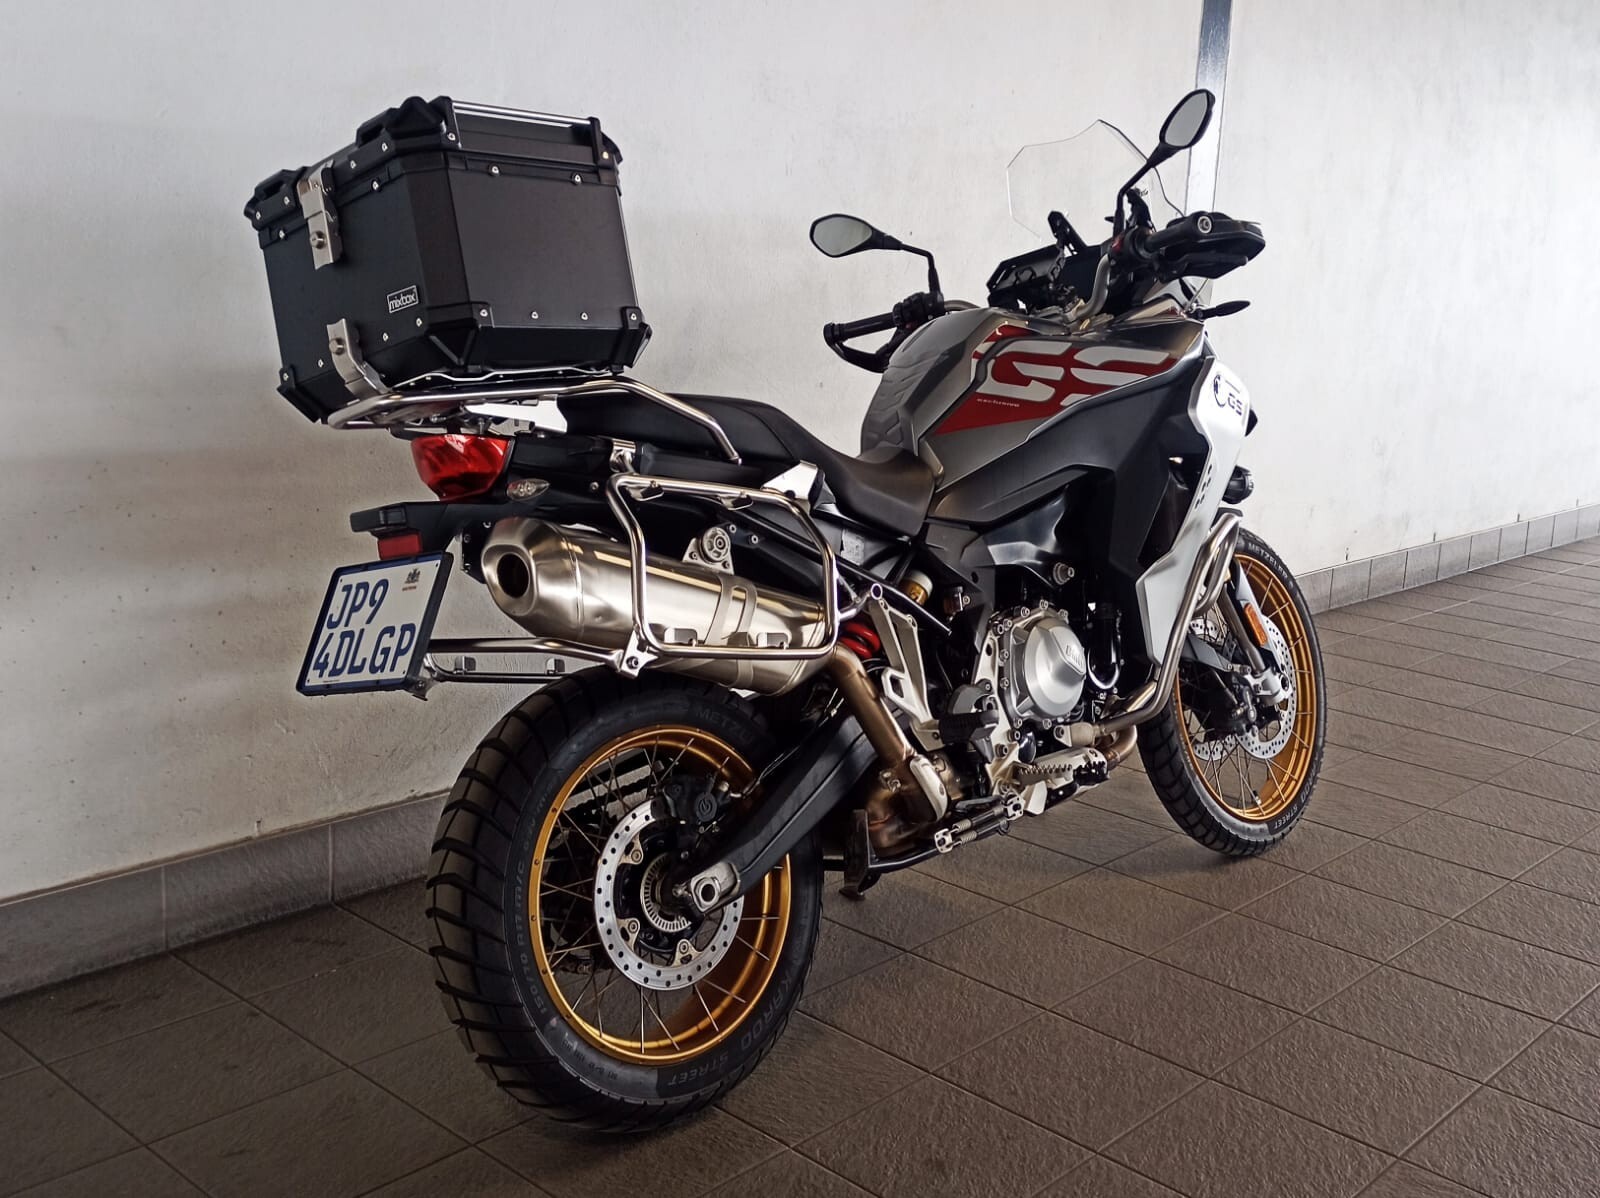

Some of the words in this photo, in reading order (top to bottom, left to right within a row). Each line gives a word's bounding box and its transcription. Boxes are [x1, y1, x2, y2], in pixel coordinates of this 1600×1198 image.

[389, 293, 416, 310] mixbox
[326, 578, 389, 630] JP9
[312, 622, 417, 678] 4DLGP
[1274, 803, 1298, 829] STREET
[667, 1050, 728, 1087] STREET
